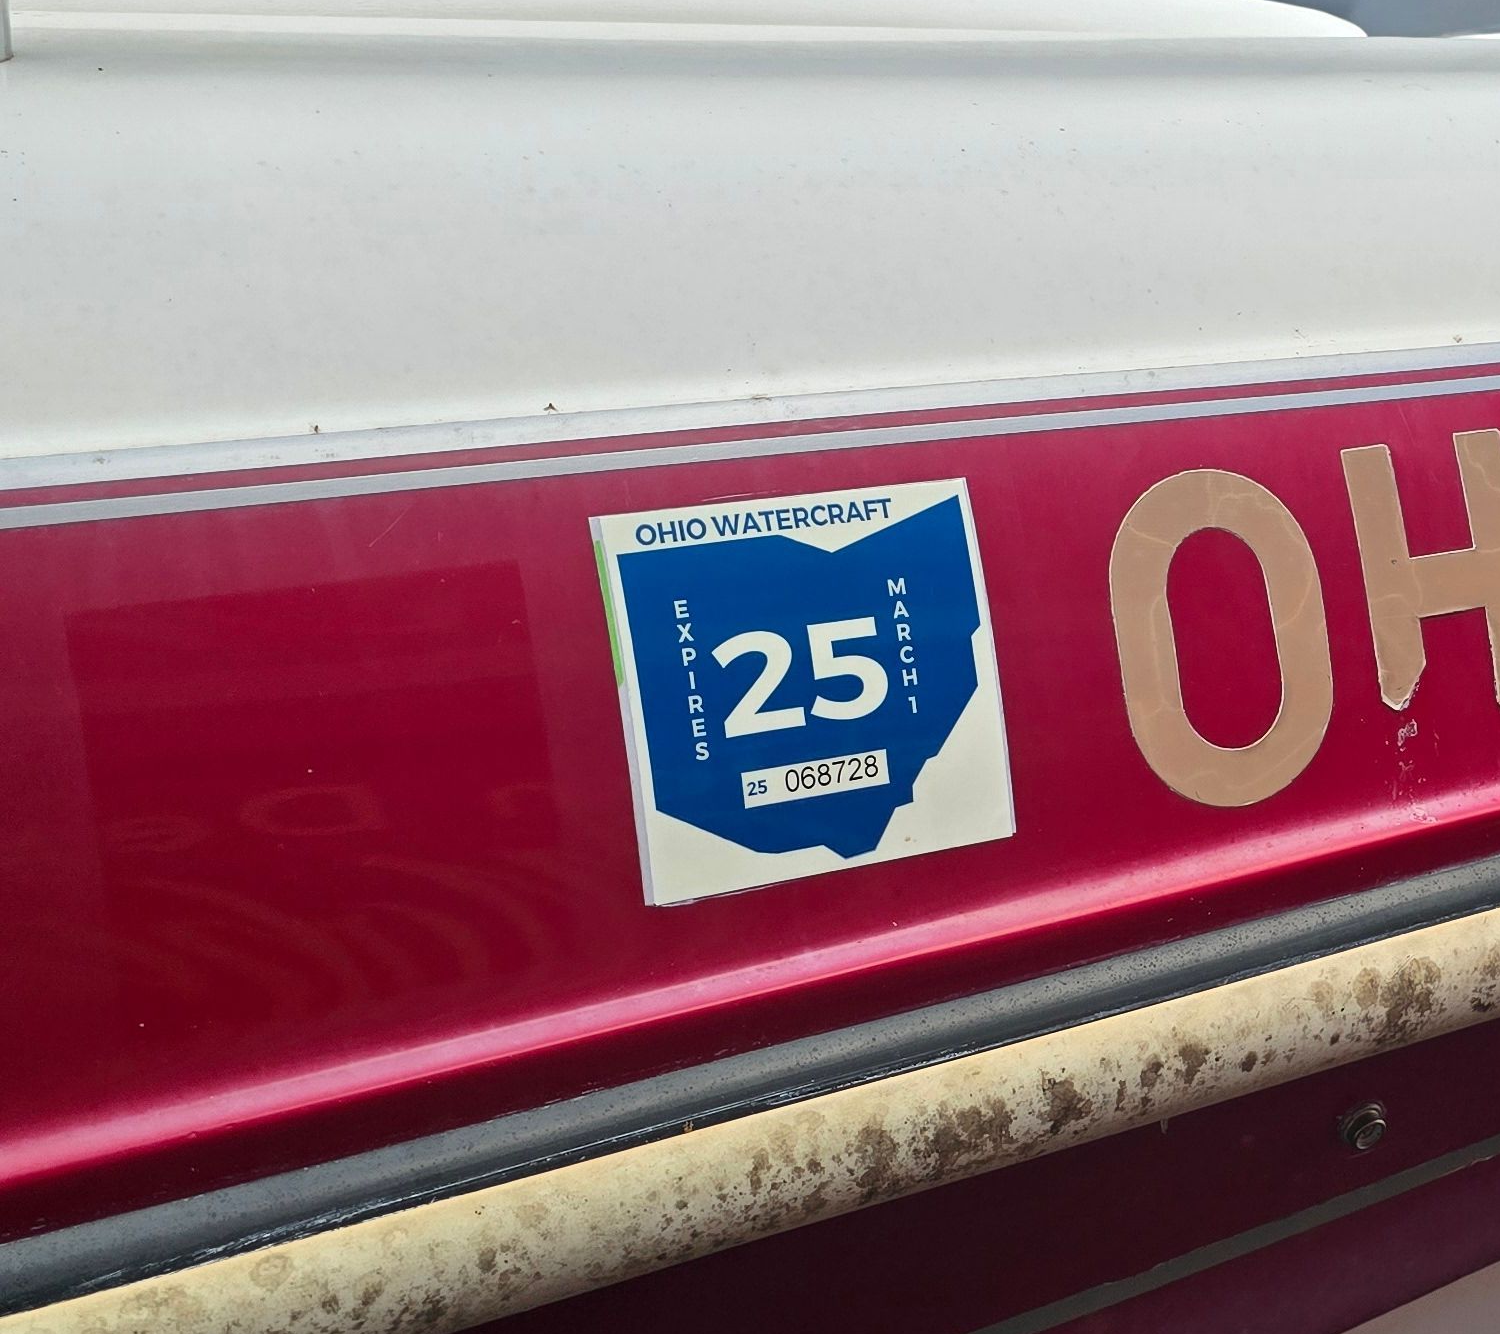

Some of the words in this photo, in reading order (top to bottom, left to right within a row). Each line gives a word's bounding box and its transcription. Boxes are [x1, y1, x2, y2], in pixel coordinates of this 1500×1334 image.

[634, 517, 707, 546] OHIO
[711, 498, 892, 536] WATERCRAFT
[673, 599, 710, 760] EXPIRES
[711, 616, 889, 739] 25
[887, 577, 918, 686] MARCH
[908, 696, 918, 714] 1
[746, 779, 768, 797] 25
[784, 754, 879, 793] 068728
